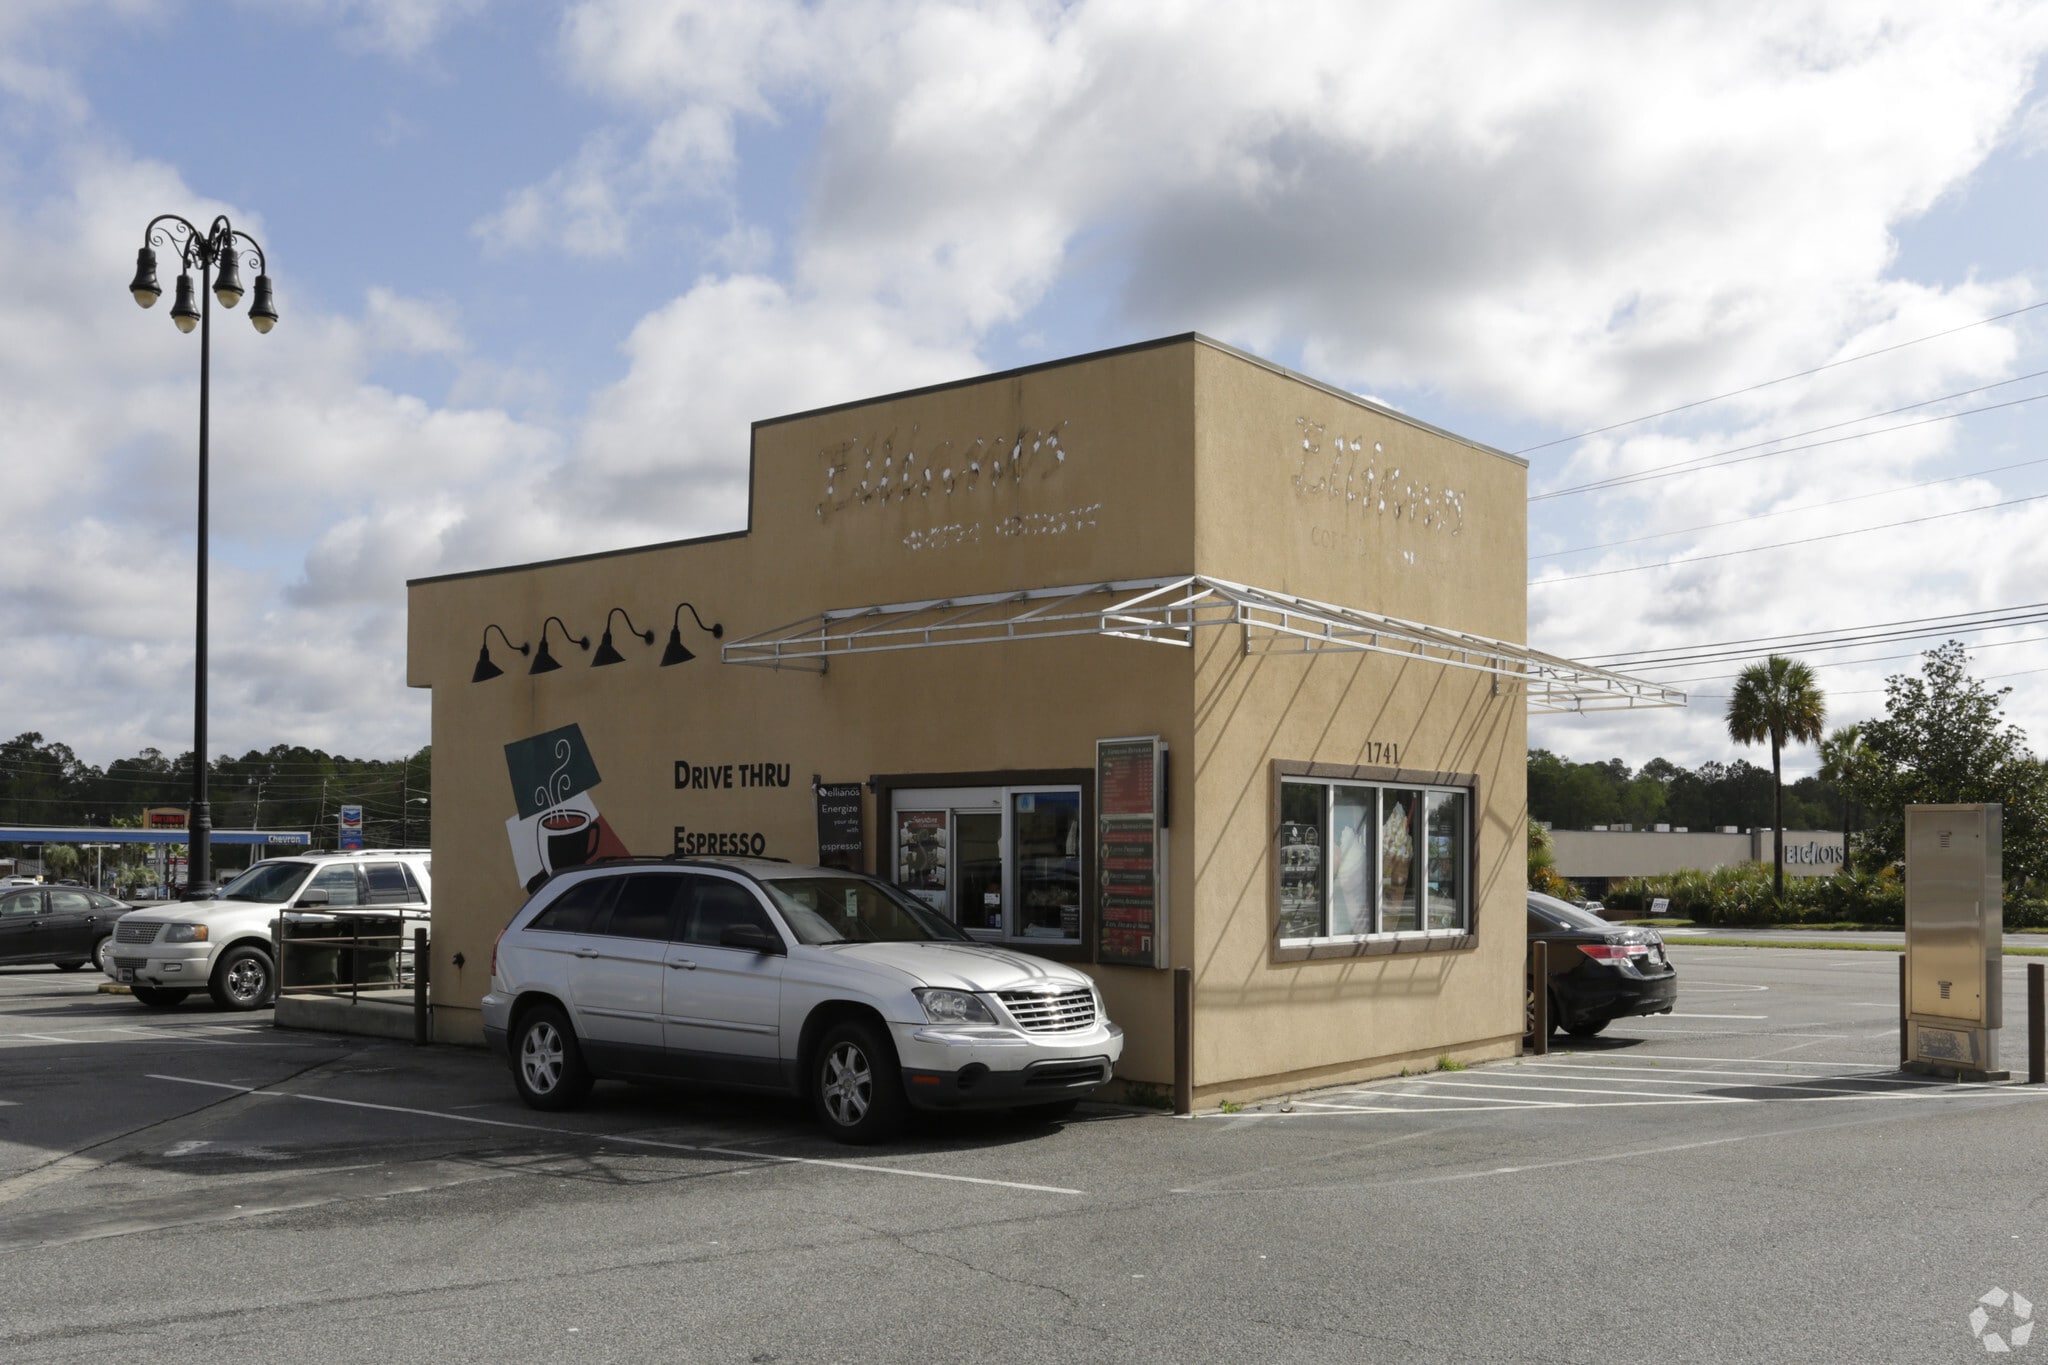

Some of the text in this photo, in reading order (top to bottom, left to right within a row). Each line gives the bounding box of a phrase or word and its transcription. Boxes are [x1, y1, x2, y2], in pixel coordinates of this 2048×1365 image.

[1367, 741, 1399, 765] 1741
[674, 760, 791, 790] DRIVE THRU
[827, 787, 860, 797] ellianos
[821, 804, 858, 815] Energize
[268, 835, 301, 844] Chevron
[674, 826, 766, 856] ESPRESSO
[821, 841, 862, 852] espresso!
